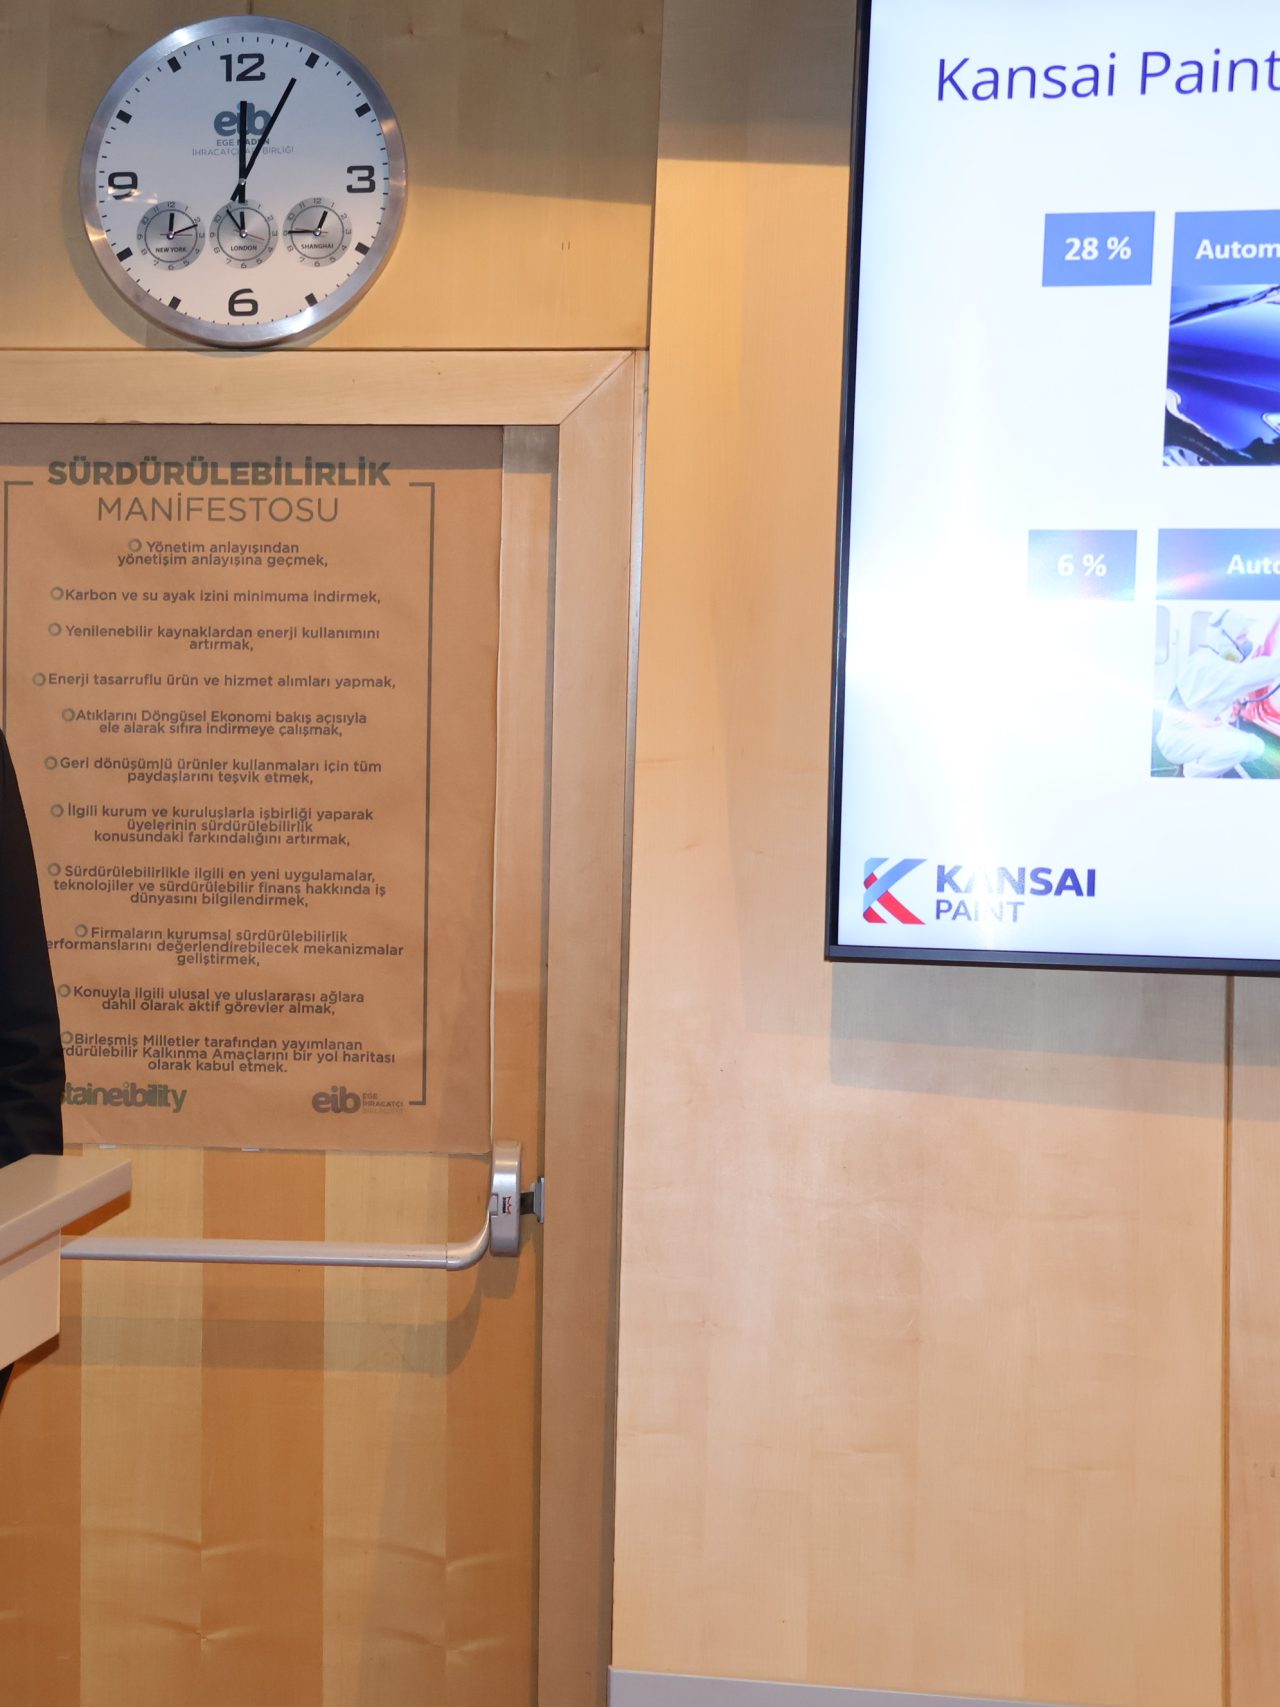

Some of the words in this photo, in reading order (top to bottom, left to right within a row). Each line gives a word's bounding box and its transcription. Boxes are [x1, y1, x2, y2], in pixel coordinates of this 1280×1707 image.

[219, 53, 266, 82] 12
[937, 52, 1116, 101] Kansai
[1140, 48, 1280, 95] Paint
[108, 171, 138, 200] 9
[346, 165, 376, 194] 3
[1064, 237, 1099, 260] 28
[1107, 236, 1131, 260] %
[1195, 239, 1280, 260] Autom
[228, 288, 259, 317] 6
[47, 455, 391, 486] SÜRDÜRÜLEBİLİRLİK
[98, 492, 338, 522] MANİFESTOSU
[146, 541, 205, 553] Yönetim
[209, 541, 299, 555] anlayışından
[118, 553, 187, 567] yönetişim
[191, 554, 262, 567] anlayışına
[267, 554, 328, 568] geçmek,
[1057, 554, 1074, 576] 6
[1082, 554, 1107, 576] %
[65, 589, 117, 601] Karbon
[121, 592, 138, 601] ve
[143, 592, 158, 601] su
[163, 589, 195, 603] ayak
[200, 590, 229, 601] izini
[233, 590, 309, 602] minimuma
[313, 590, 381, 604] indirmek,
[65, 625, 153, 637] Yenilenebilir
[158, 626, 252, 640] kaynaklardan
[257, 627, 297, 640] enerji
[302, 627, 380, 639] kullanımını
[189, 639, 254, 652] artırmak,
[48, 673, 89, 687] Enerji
[94, 674, 162, 685] tasarruflu
[167, 674, 198, 686] ürün
[203, 677, 219, 686] ve
[224, 674, 273, 686] hizmet
[277, 675, 330, 687] alımları
[335, 676, 396, 689] yapmak,
[75, 709, 137, 721] Atıklarını
[142, 710, 206, 723] Döngüsel
[211, 710, 271, 723] Ekonomi
[276, 711, 312, 725] bakış
[316, 712, 367, 726] açısıyla
[99, 722, 120, 733] ele
[123, 722, 164, 733] alarak
[169, 722, 202, 734] sıfıra
[206, 723, 275, 736] indirmeye
[279, 724, 343, 737] çalışmak,
[60, 757, 89, 769] Geri
[94, 757, 173, 771] dönüşümlü
[177, 758, 228, 770] ürünler
[233, 759, 319, 771] kullanmaları
[324, 760, 349, 773] için
[353, 760, 382, 772] tüm
[128, 771, 213, 784] paydaşlarını
[218, 772, 259, 784] teşvik
[264, 772, 313, 784] etmek,
[68, 802, 97, 818] İlgili
[102, 805, 147, 817] kurum
[152, 808, 168, 817] ve
[172, 806, 255, 820] kuruluşlarla
[259, 807, 312, 821] işbirliği
[316, 808, 373, 822] yaparak
[127, 819, 197, 832] üyelerinin
[201, 820, 313, 832] sürdürülebilirlik
[94, 830, 183, 842] konusundaki
[188, 831, 281, 846] farkındalığını
[286, 833, 350, 847] artırmak,
[65, 865, 190, 879] Sürdürülebilirlikle
[194, 867, 224, 881] ilgili
[228, 870, 245, 879] en
[250, 868, 279, 882] yeni
[285, 869, 375, 883] uygulamalar,
[936, 864, 1096, 897] KANSAI
[54, 879, 134, 893] teknolojiler
[139, 882, 154, 891] ve
[159, 880, 254, 893] sürdürülebilir
[258, 882, 301, 894] finans
[305, 882, 370, 895] hakkında
[375, 883, 386, 896] iş
[130, 892, 197, 906] dünyasını
[202, 894, 308, 908] bilgilendirmek,
[935, 899, 1025, 923] PAINT
[91, 927, 162, 940] Firmaların
[167, 928, 231, 940] kurumsal
[236, 929, 348, 942] sürdürülebilirlik
[47, 938, 151, 951] erformanslarını
[156, 939, 299, 954] değerlendirebilecek
[303, 943, 404, 956] mekanizmalar
[177, 953, 260, 967] geliştirmek,
[73, 986, 130, 1000] Konuyla
[135, 987, 164, 1001] ilgili
[169, 988, 210, 1000] ulusal
[215, 991, 230, 1000] ve
[235, 989, 315, 1002] uluslararası
[320, 991, 364, 1004] ağlara
[102, 999, 136, 1010] dahil
[140, 1000, 184, 1011] olarak
[188, 1000, 221, 1012] aktif
[224, 1001, 285, 1014] görevler
[288, 1003, 335, 1015] almak,
[75, 1033, 138, 1046] Birleşmiş
[143, 1035, 200, 1047] Milletler
[205, 1036, 277, 1048] tarafından
[282, 1038, 362, 1051] yayımlanan
[62, 1045, 138, 1058] dürülebilir
[142, 1047, 207, 1059] Kalkınma
[212, 1049, 288, 1063] Amaçlarını
[293, 1050, 312, 1062] bir
[317, 1051, 338, 1064] yol
[343, 1051, 395, 1063] haritası
[148, 1059, 191, 1071] olarak
[196, 1060, 234, 1072] kabul
[239, 1061, 288, 1073] etmek.
[61, 1081, 188, 1113] taineibility
[312, 1085, 361, 1114] eib
